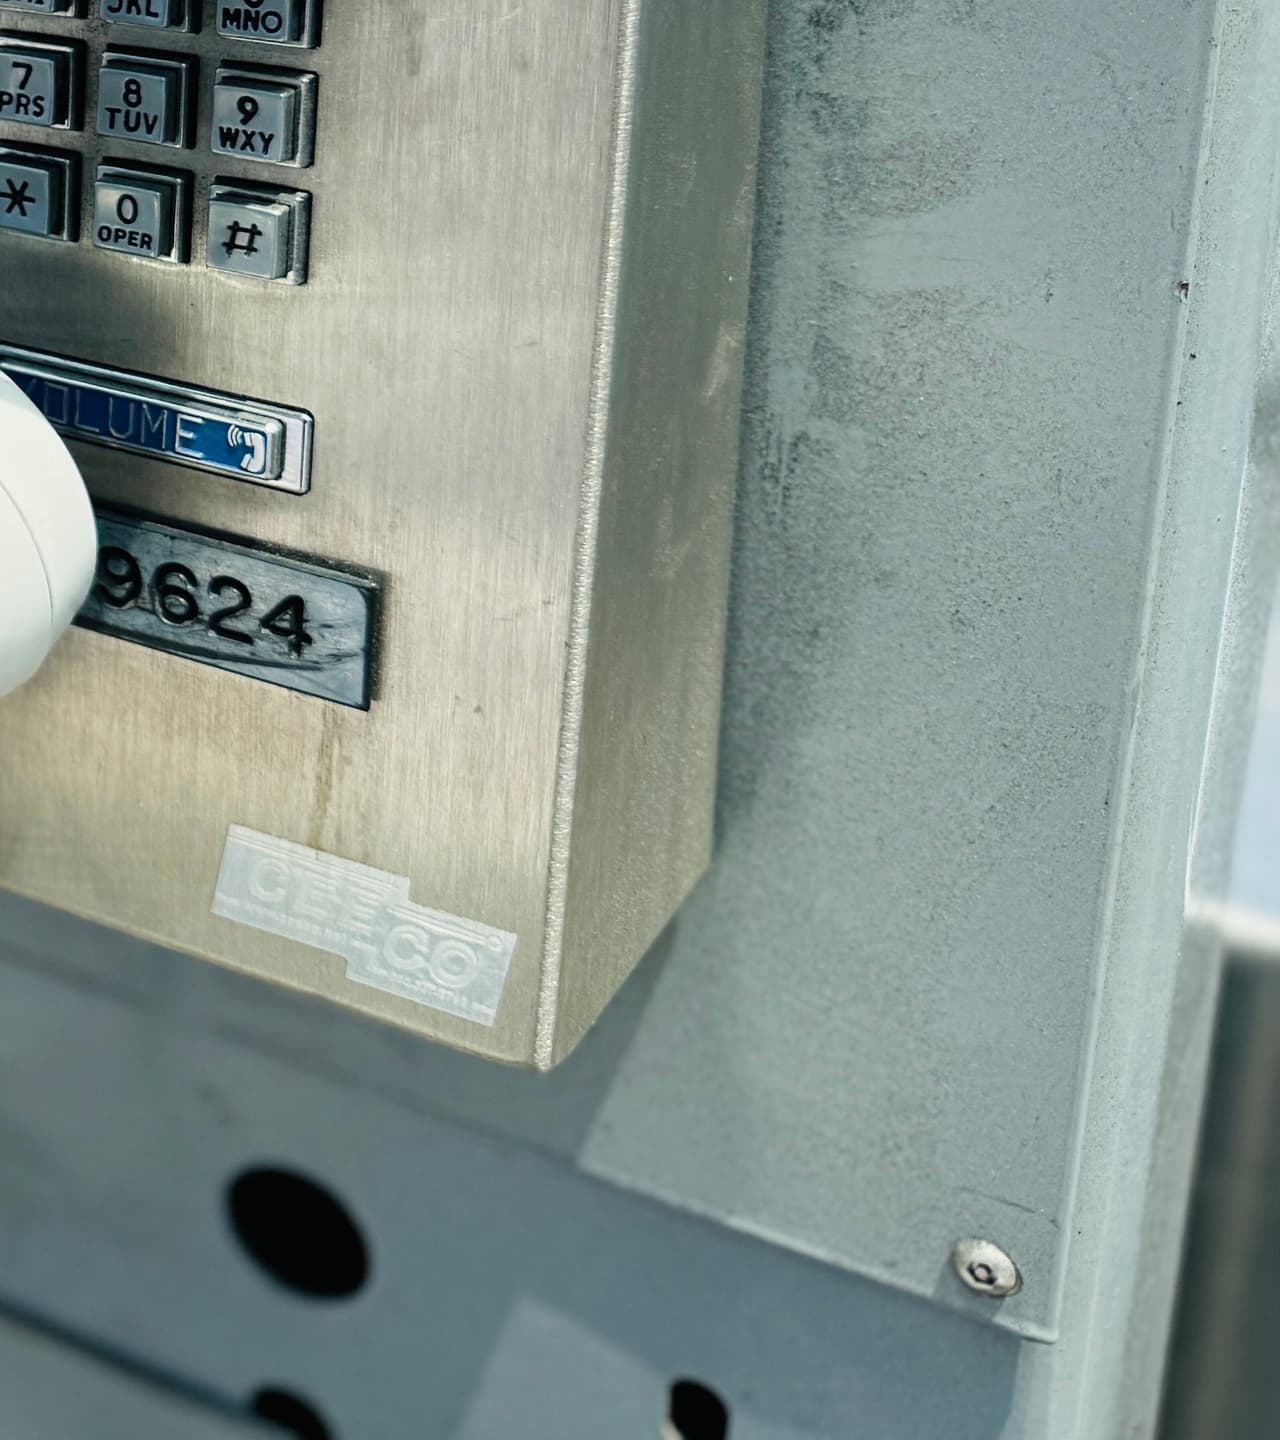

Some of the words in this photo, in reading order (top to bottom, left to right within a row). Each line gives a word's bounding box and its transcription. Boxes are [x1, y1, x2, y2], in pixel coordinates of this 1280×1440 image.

[221, 8, 282, 35] MNO
[11, 62, 32, 91] 7
[123, 78, 142, 109] 8
[105, 108, 158, 136] TUV
[237, 96, 259, 126] 9
[218, 126, 275, 155] WXY
[116, 193, 139, 225] 0
[97, 225, 152, 252] OPER
